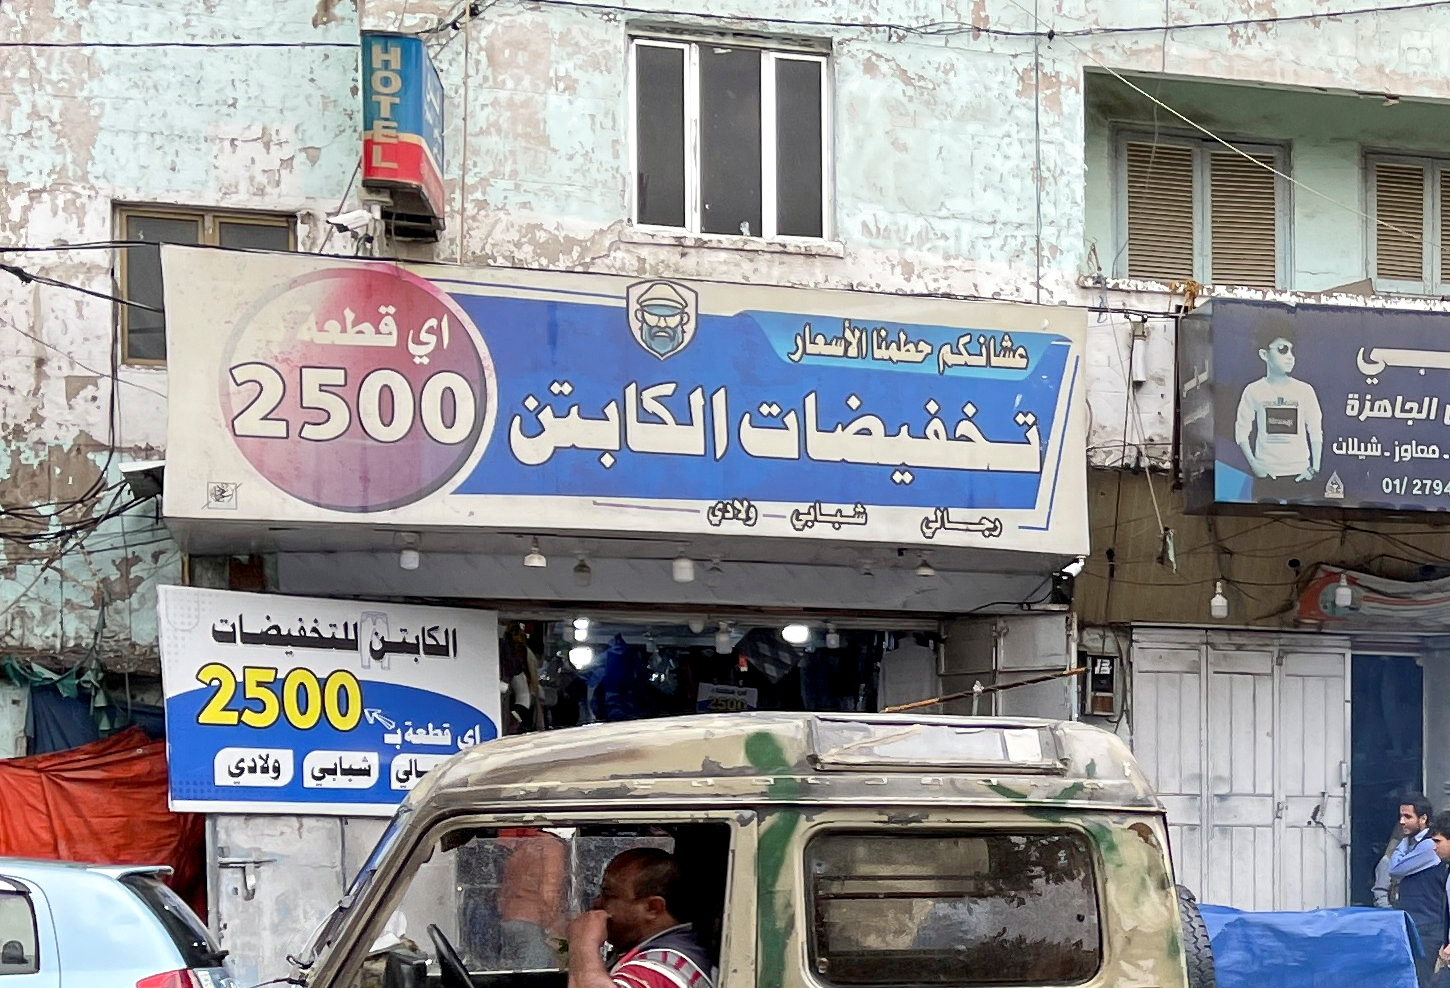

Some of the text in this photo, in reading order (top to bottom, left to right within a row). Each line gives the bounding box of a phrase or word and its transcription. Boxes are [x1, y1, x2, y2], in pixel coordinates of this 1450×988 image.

[371, 43, 402, 168] HOTEL
[407, 313, 449, 365] اي
[787, 318, 1029, 376] عشانكم حطمنا الأسعار
[229, 361, 476, 446] 2500
[1345, 393, 1438, 427] الجاهزة
[509, 382, 1042, 486] تخفيضات الكابتن
[1331, 436, 1382, 460] شيلان
[1393, 440, 1440, 462] معاوز
[211, 613, 457, 663] الكابتن للتخفيضات
[196, 662, 363, 731] 2500
[404, 721, 452, 746] قطعة
